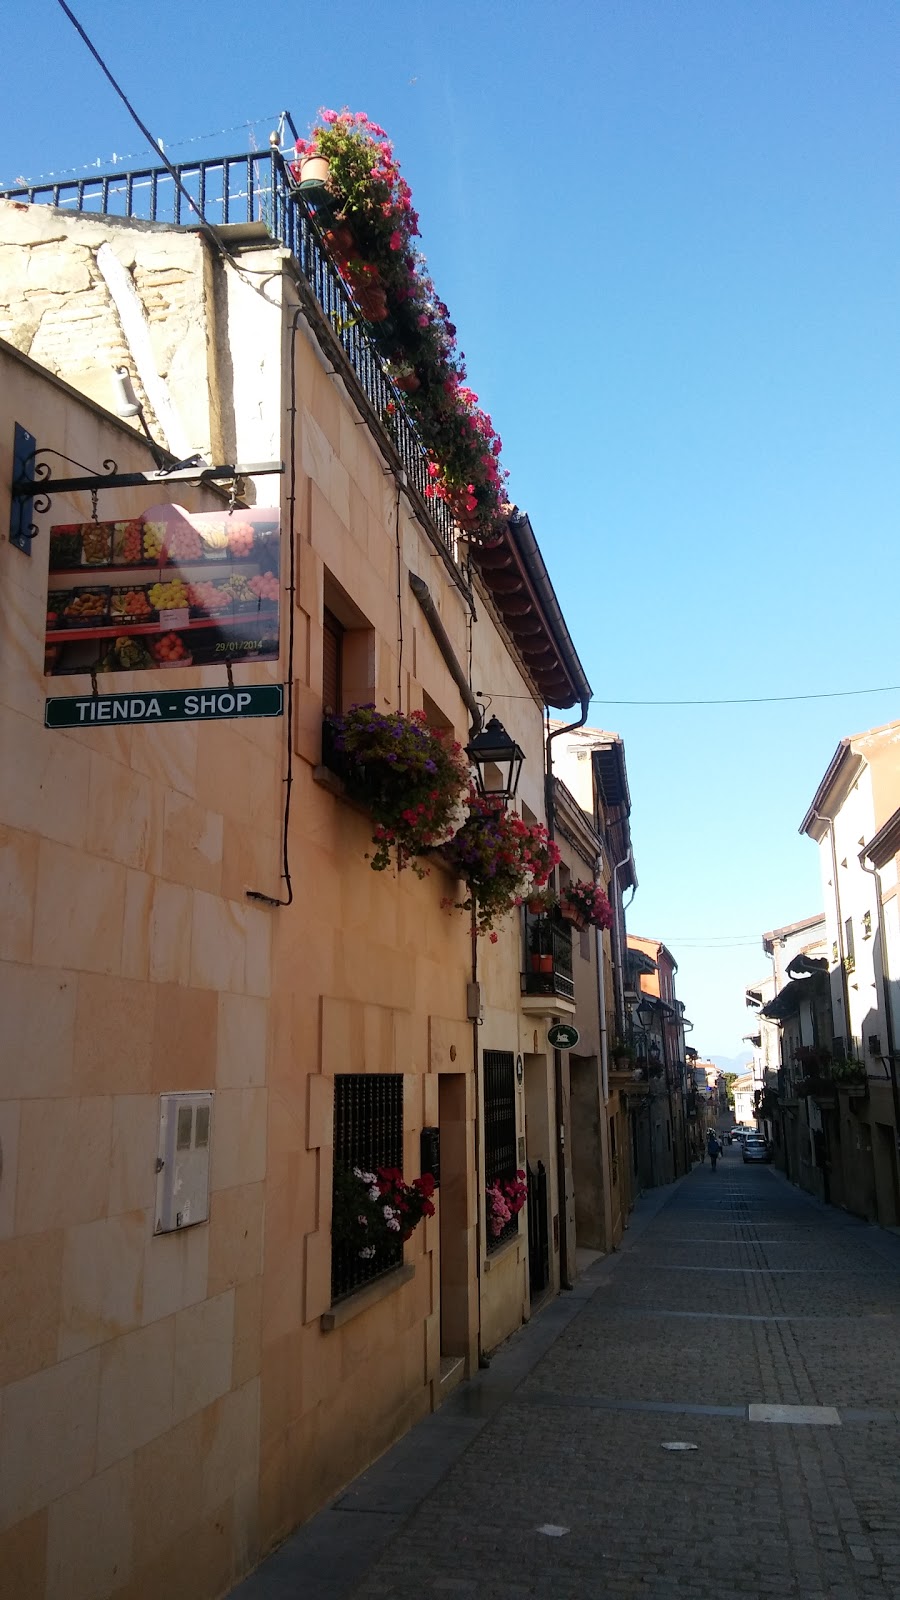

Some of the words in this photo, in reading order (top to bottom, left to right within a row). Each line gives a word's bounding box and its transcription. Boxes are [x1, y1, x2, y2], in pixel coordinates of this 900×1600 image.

[215, 640, 263, 652] 29/01/2014
[76, 698, 162, 721] TIENDA
[184, 692, 252, 715] SHOP
